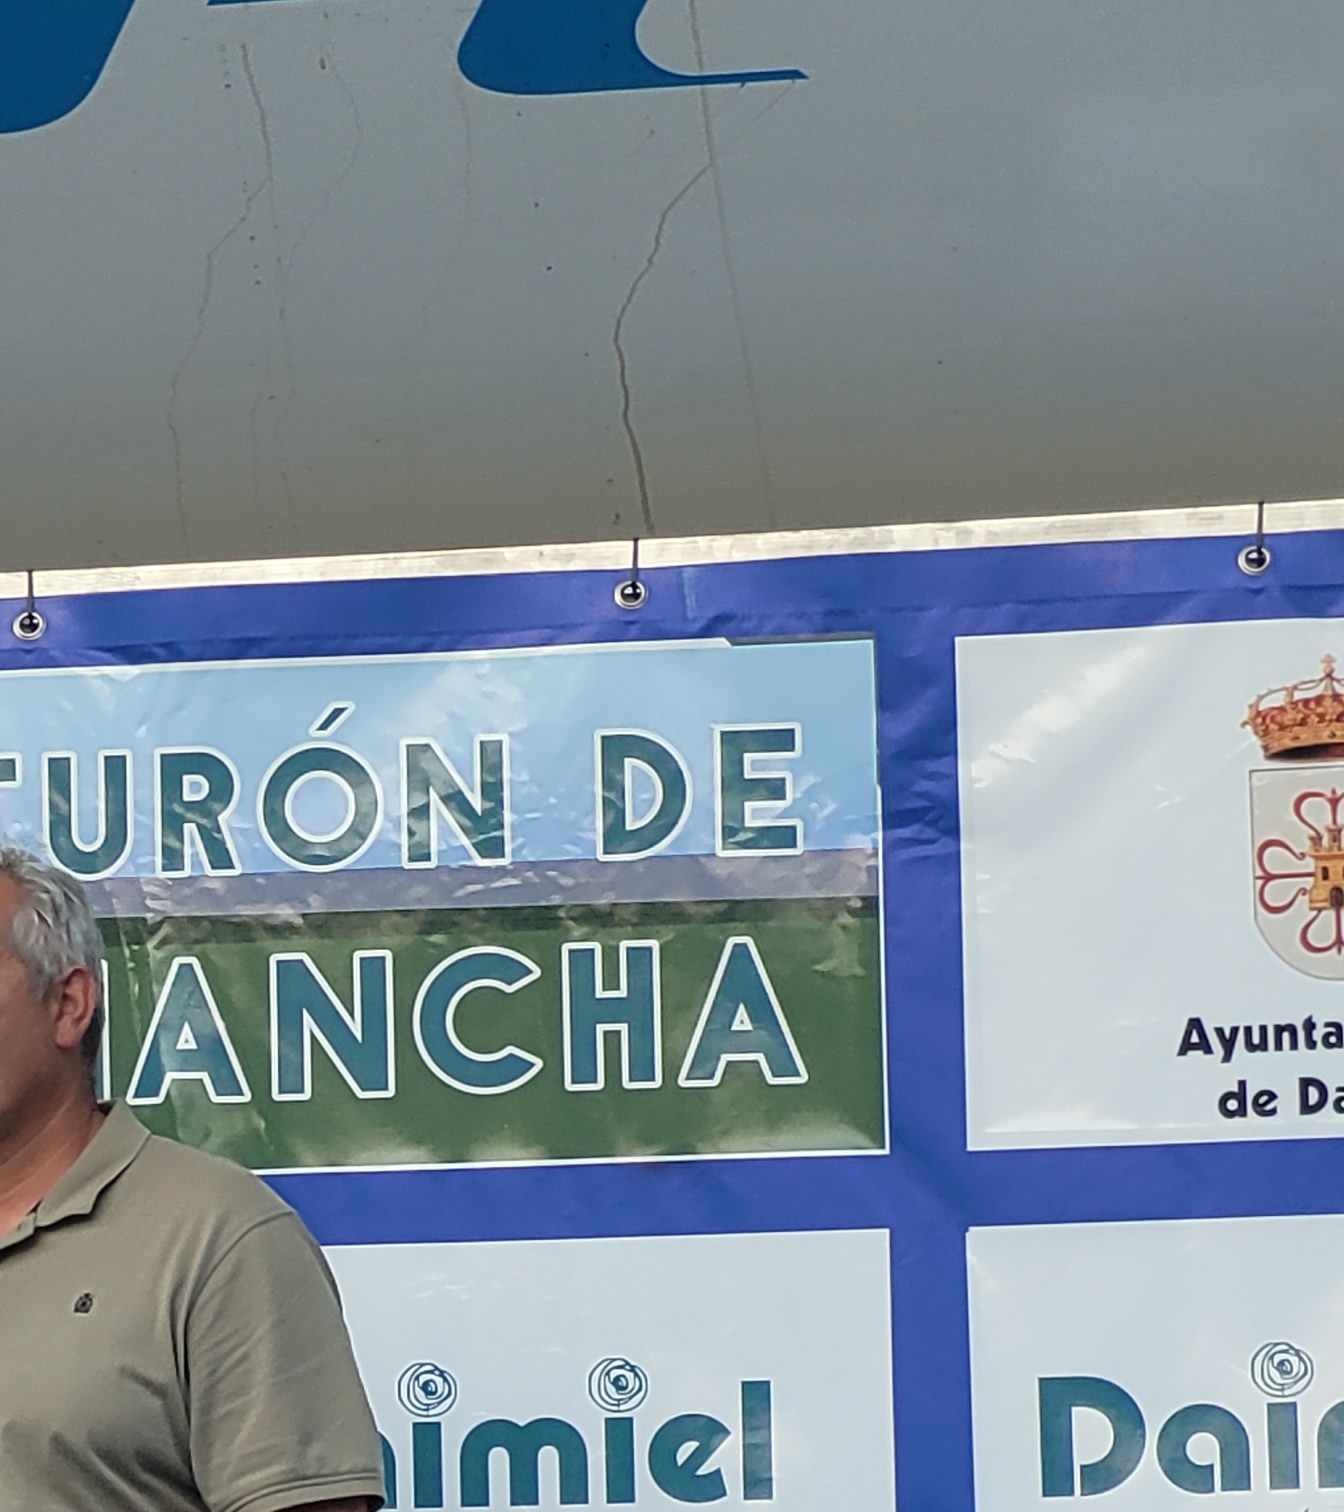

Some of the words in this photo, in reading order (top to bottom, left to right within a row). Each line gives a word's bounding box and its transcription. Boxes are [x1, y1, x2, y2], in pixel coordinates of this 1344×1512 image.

[592, 721, 805, 863] DE
[96, 935, 808, 1107] ANCHA
[1218, 1079, 1278, 1119] de
